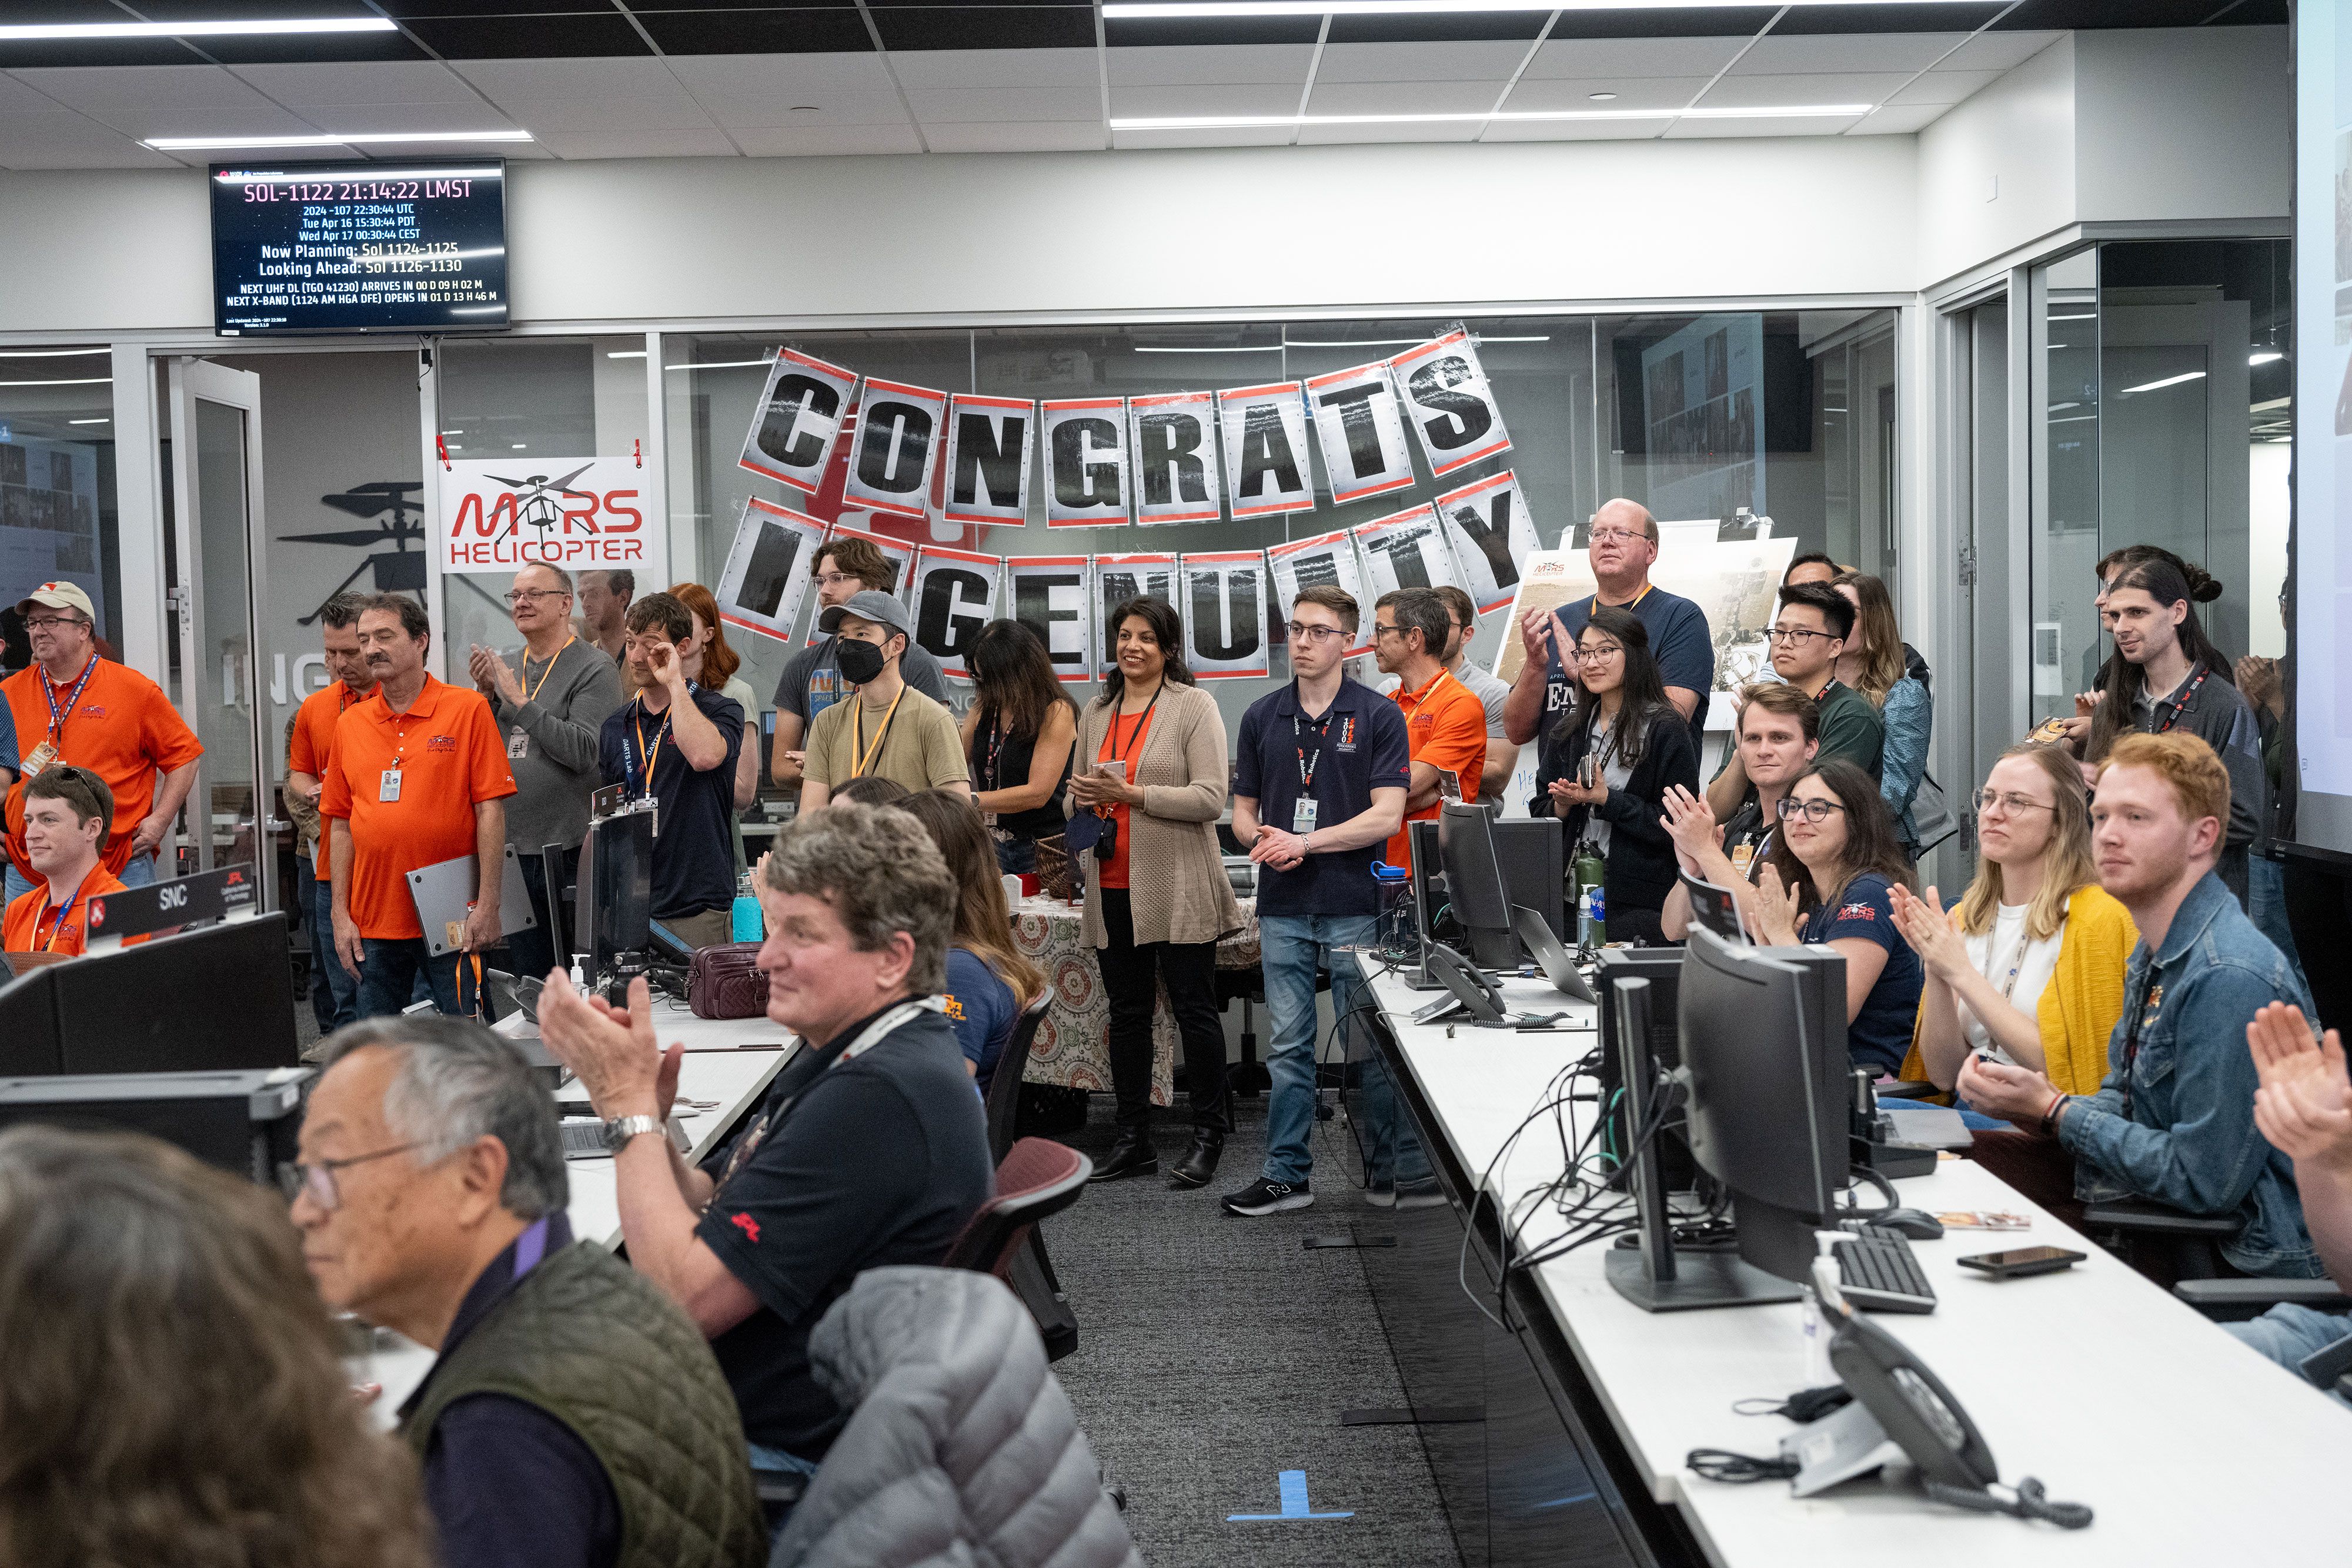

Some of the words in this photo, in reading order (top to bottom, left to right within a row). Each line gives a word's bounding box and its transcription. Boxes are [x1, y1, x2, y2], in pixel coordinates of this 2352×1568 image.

[244, 183, 333, 202] SOL-1122
[340, 182, 419, 200] 21:14:22
[426, 180, 472, 198] LMST
[303, 206, 326, 216] 2024
[329, 206, 350, 215] -107
[354, 205, 394, 215] 22:30:44
[396, 203, 414, 213] UTC
[303, 219, 319, 228] Tue
[322, 218, 338, 229] Apr
[341, 218, 352, 228] 16
[355, 218, 395, 227] 15:30:44
[397, 216, 415, 226] PDT
[299, 231, 320, 241] Wed
[323, 231, 339, 242] Apr
[342, 231, 353, 240] 17
[355, 230, 396, 240] 00:30:44
[399, 229, 420, 239] CEST
[262, 245, 290, 259] Now
[295, 243, 358, 259] Planning:
[362, 243, 382, 256] Sol
[387, 242, 458, 256] 1124-1125
[259, 262, 312, 278] Looking
[316, 261, 362, 275] Ahead:
[366, 260, 386, 273] Sol
[391, 259, 462, 273] 1126-1130
[240, 284, 263, 294] NEXT
[266, 283, 285, 293] UHF
[288, 283, 299, 293] DL
[302, 282, 323, 293] (TGO
[326, 281, 359, 292] 41230)
[362, 281, 400, 291] ARRIVES
[403, 280, 413, 290] IN
[416, 280, 427, 290] 00
[430, 280, 436, 289] D
[438, 280, 450, 290] 09
[452, 280, 459, 289] H
[460, 280, 472, 289] 02
[475, 280, 482, 289] M
[227, 296, 250, 306] NEXT
[252, 296, 289, 306] X-BAND
[292, 295, 319, 306] (1124
[321, 295, 336, 305] AM
[339, 294, 358, 304] HGA
[361, 293, 382, 304] DFE)
[385, 293, 415, 303] OPENS
[417, 293, 427, 302] IN
[430, 293, 442, 302] 01
[444, 292, 450, 302] D
[453, 292, 464, 302] 13
[466, 292, 473, 301] H
[475, 292, 486, 301] 46
[489, 292, 497, 300] M
[757, 356, 1492, 508] CONGRATS
[450, 539, 643, 564] HELICOPTER
[736, 491, 1519, 663] IGENUTY
[1818, 688, 1828, 701] JPL
[623, 738, 631, 760] DARTS
[1604, 739, 1618, 760] Propulsion
[625, 761, 633, 773] Lab
[1308, 748, 1320, 774] Robotics
[159, 884, 188, 911] SNC
